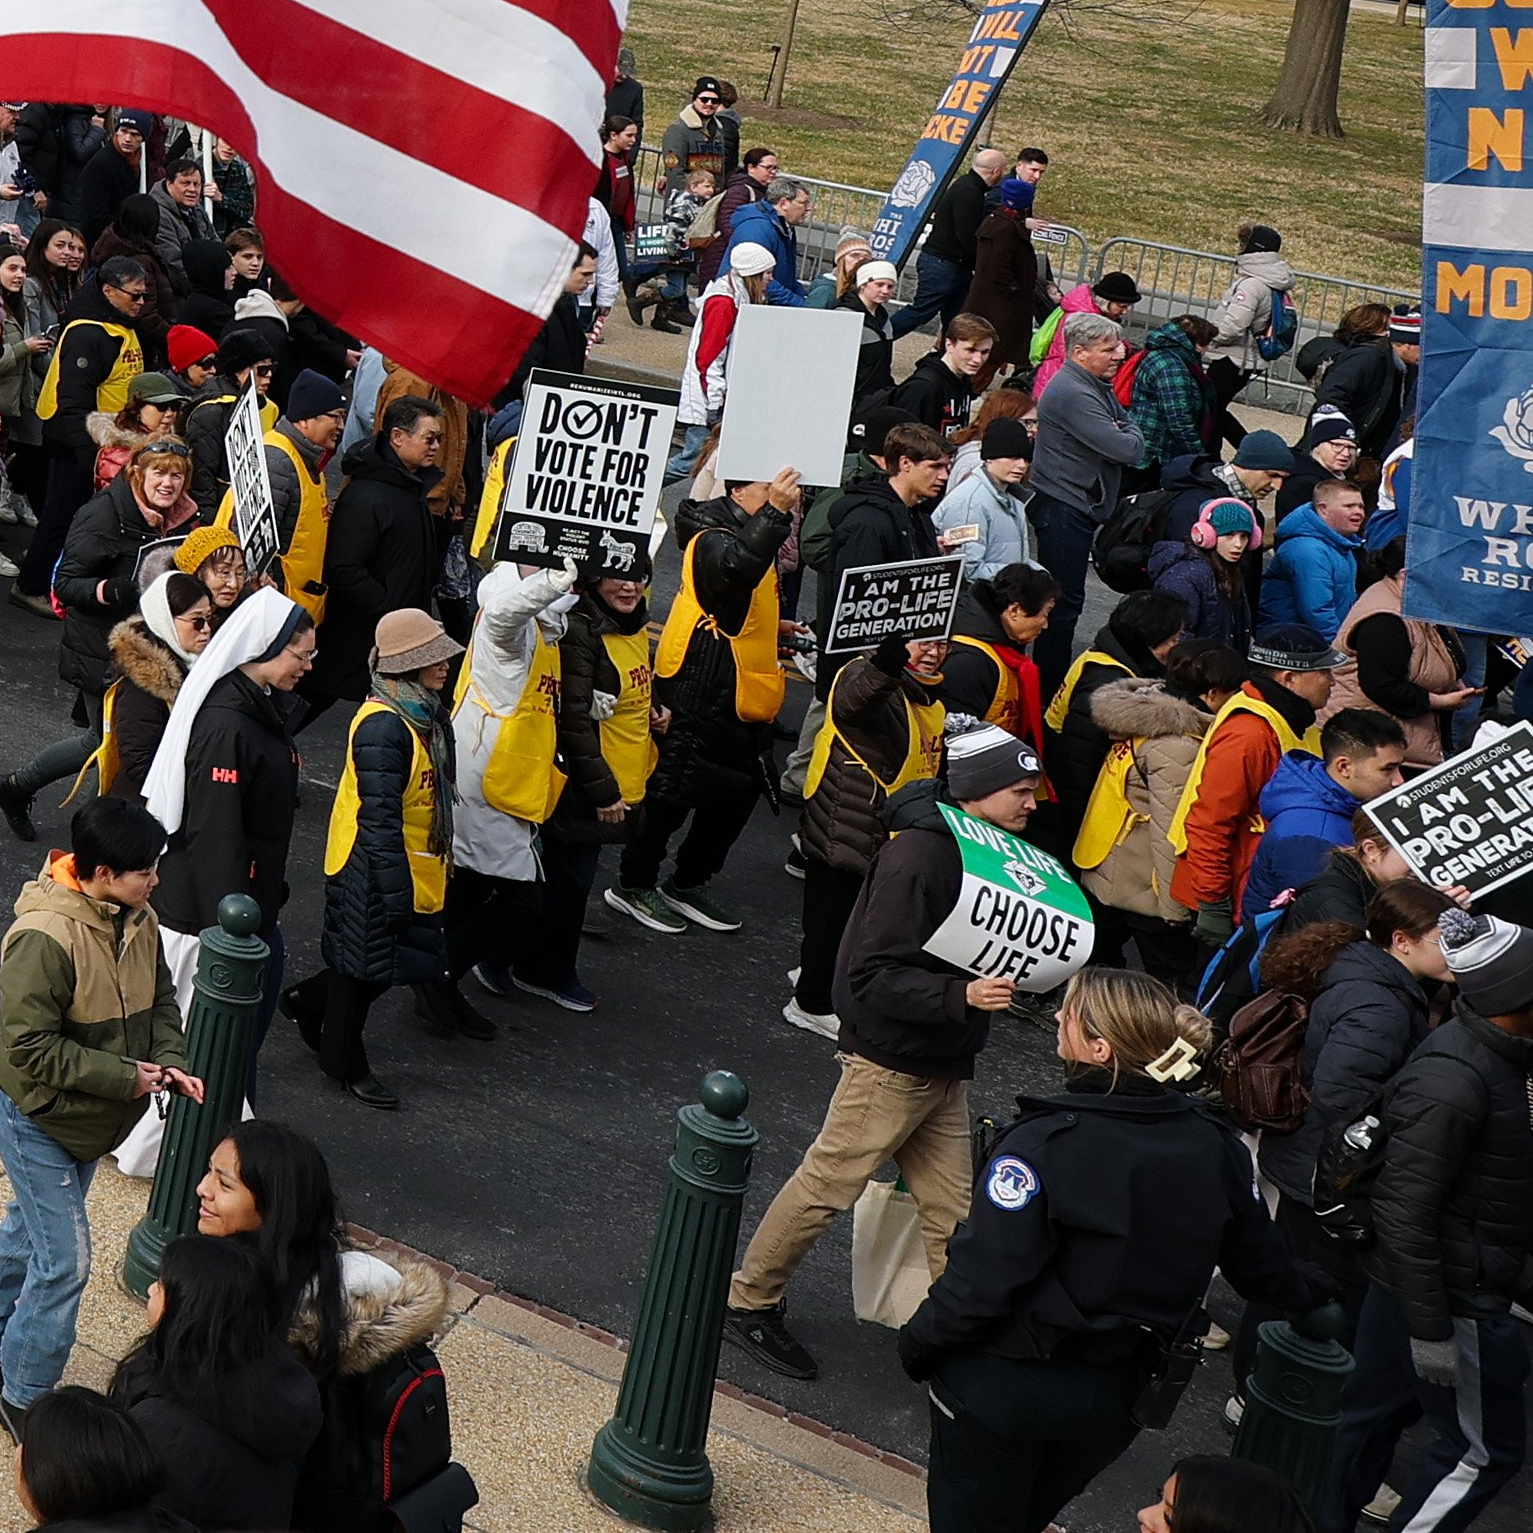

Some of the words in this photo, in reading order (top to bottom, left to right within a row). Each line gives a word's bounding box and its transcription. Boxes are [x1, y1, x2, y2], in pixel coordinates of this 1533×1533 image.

[944, 80, 992, 115] BE
[570, 382, 642, 399] REHUMANIZEINTL.ORG
[539, 392, 659, 450] DON'T
[534, 437, 598, 481] VOTE
[600, 448, 650, 489] FOR
[526, 473, 644, 527] VIOLENCE
[552, 550, 590, 562] HUMANITY
[557, 544, 588, 555] CHOOSE
[848, 585, 856, 600] I
[864, 580, 900, 597] AM
[910, 573, 952, 591] THE
[872, 564, 946, 580] STUDENTSFORLIFE.ORG
[838, 588, 955, 622] PRO-LIFE
[836, 611, 947, 640] GENERATION
[1264, 656, 1310, 668] SPORTS
[212, 768, 238, 784] HH
[1410, 742, 1512, 802] STUDENTSFORLIFE.ORG
[1391, 818, 1410, 837] I
[1418, 786, 1470, 826] AM
[1472, 748, 1533, 792] THE
[947, 810, 1018, 860] LOVE
[1012, 839, 1073, 885] LIFE
[1486, 863, 1505, 879] TEXT
[1505, 857, 1522, 870] LIFE
[970, 885, 1080, 963] CHOOSE
[968, 939, 1039, 987] LIFE
